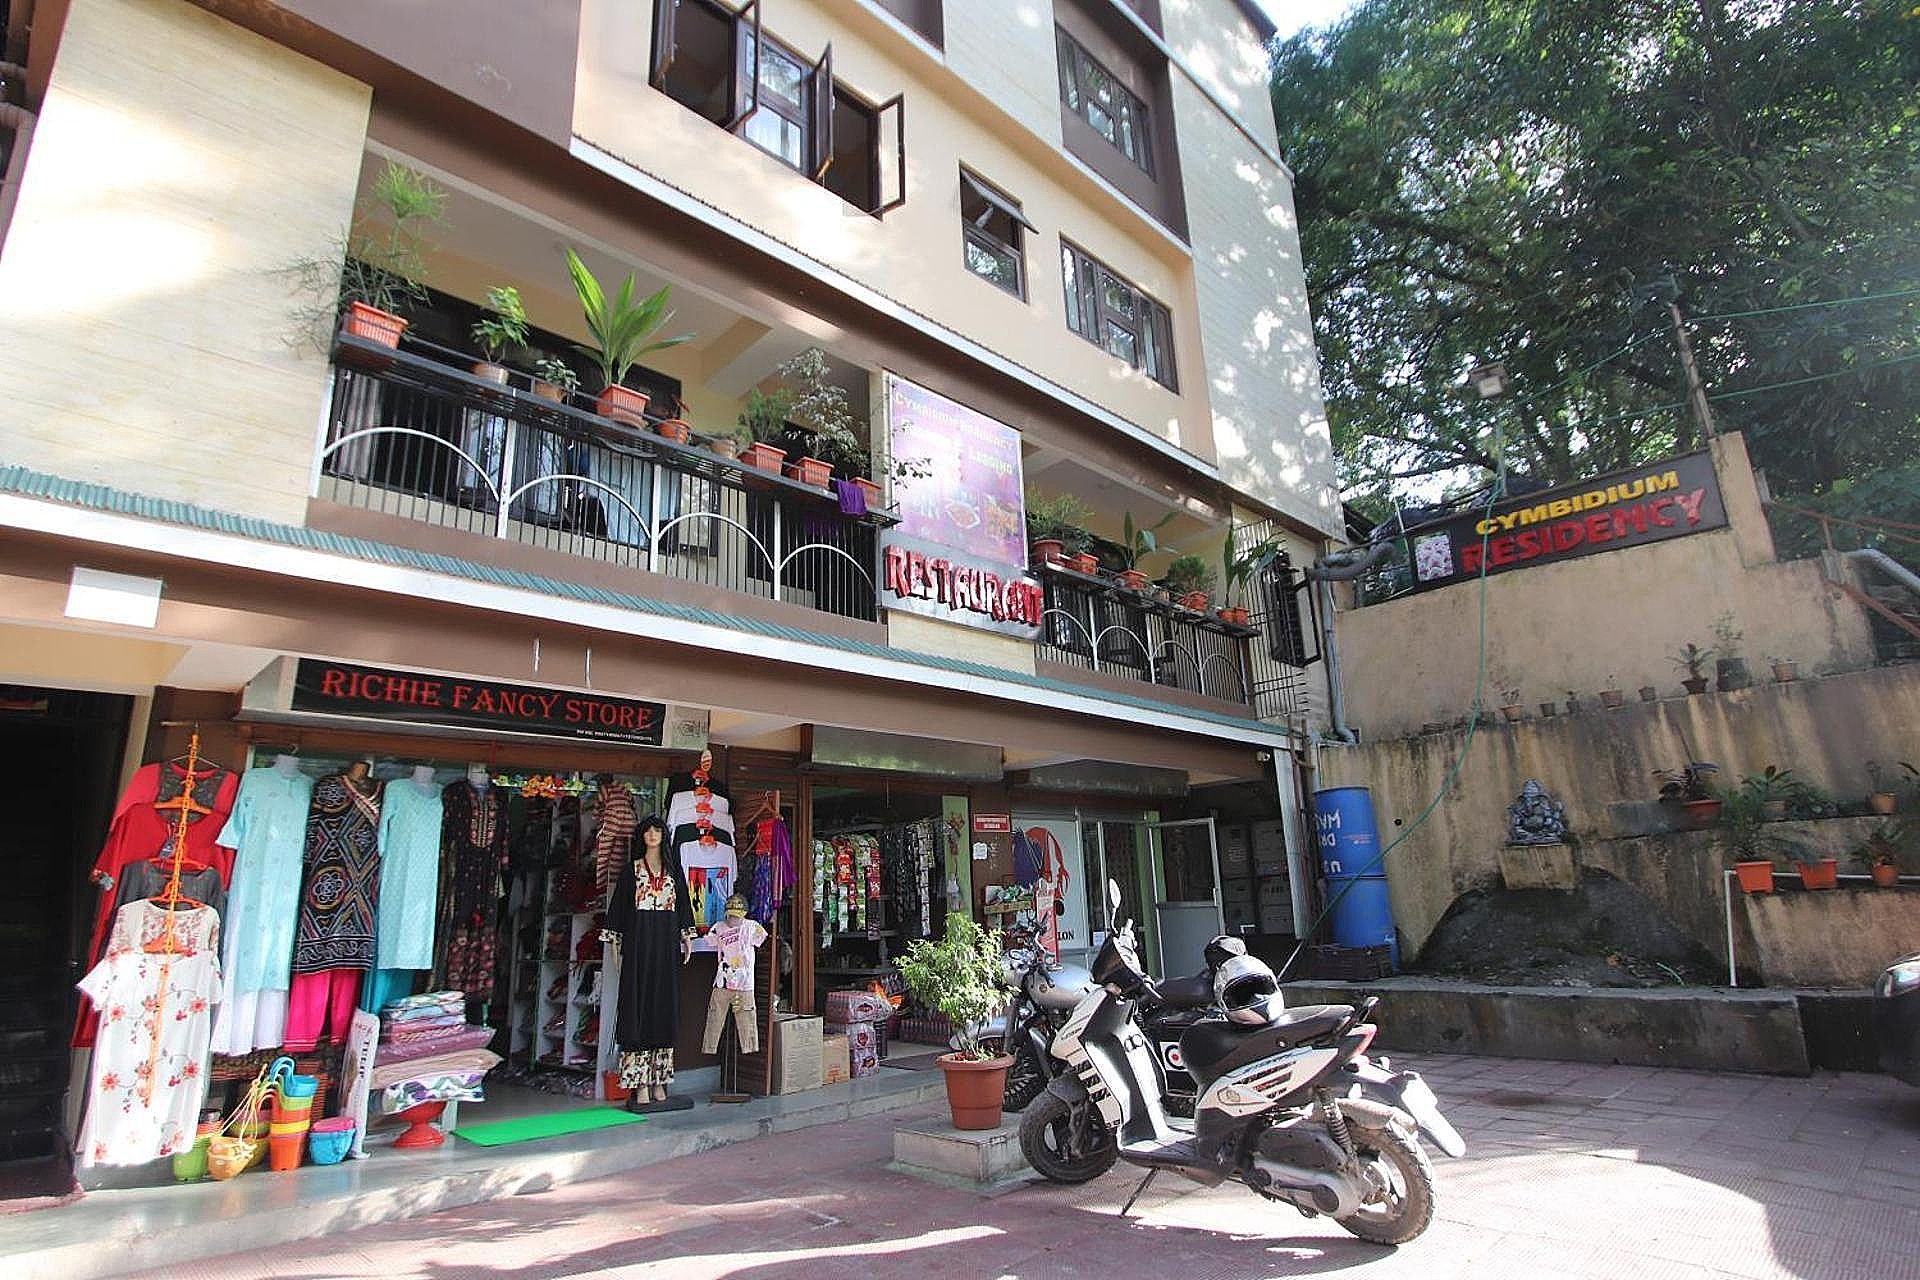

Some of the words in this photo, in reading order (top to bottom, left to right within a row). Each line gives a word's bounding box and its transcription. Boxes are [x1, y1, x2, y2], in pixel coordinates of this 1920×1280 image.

[1460, 488, 1707, 576] RESIDENCY
[1475, 470, 1679, 536] CYMBIDIUM
[321, 668, 442, 708] RICHIE
[453, 685, 562, 719] FANCY
[564, 700, 654, 731] STORE
